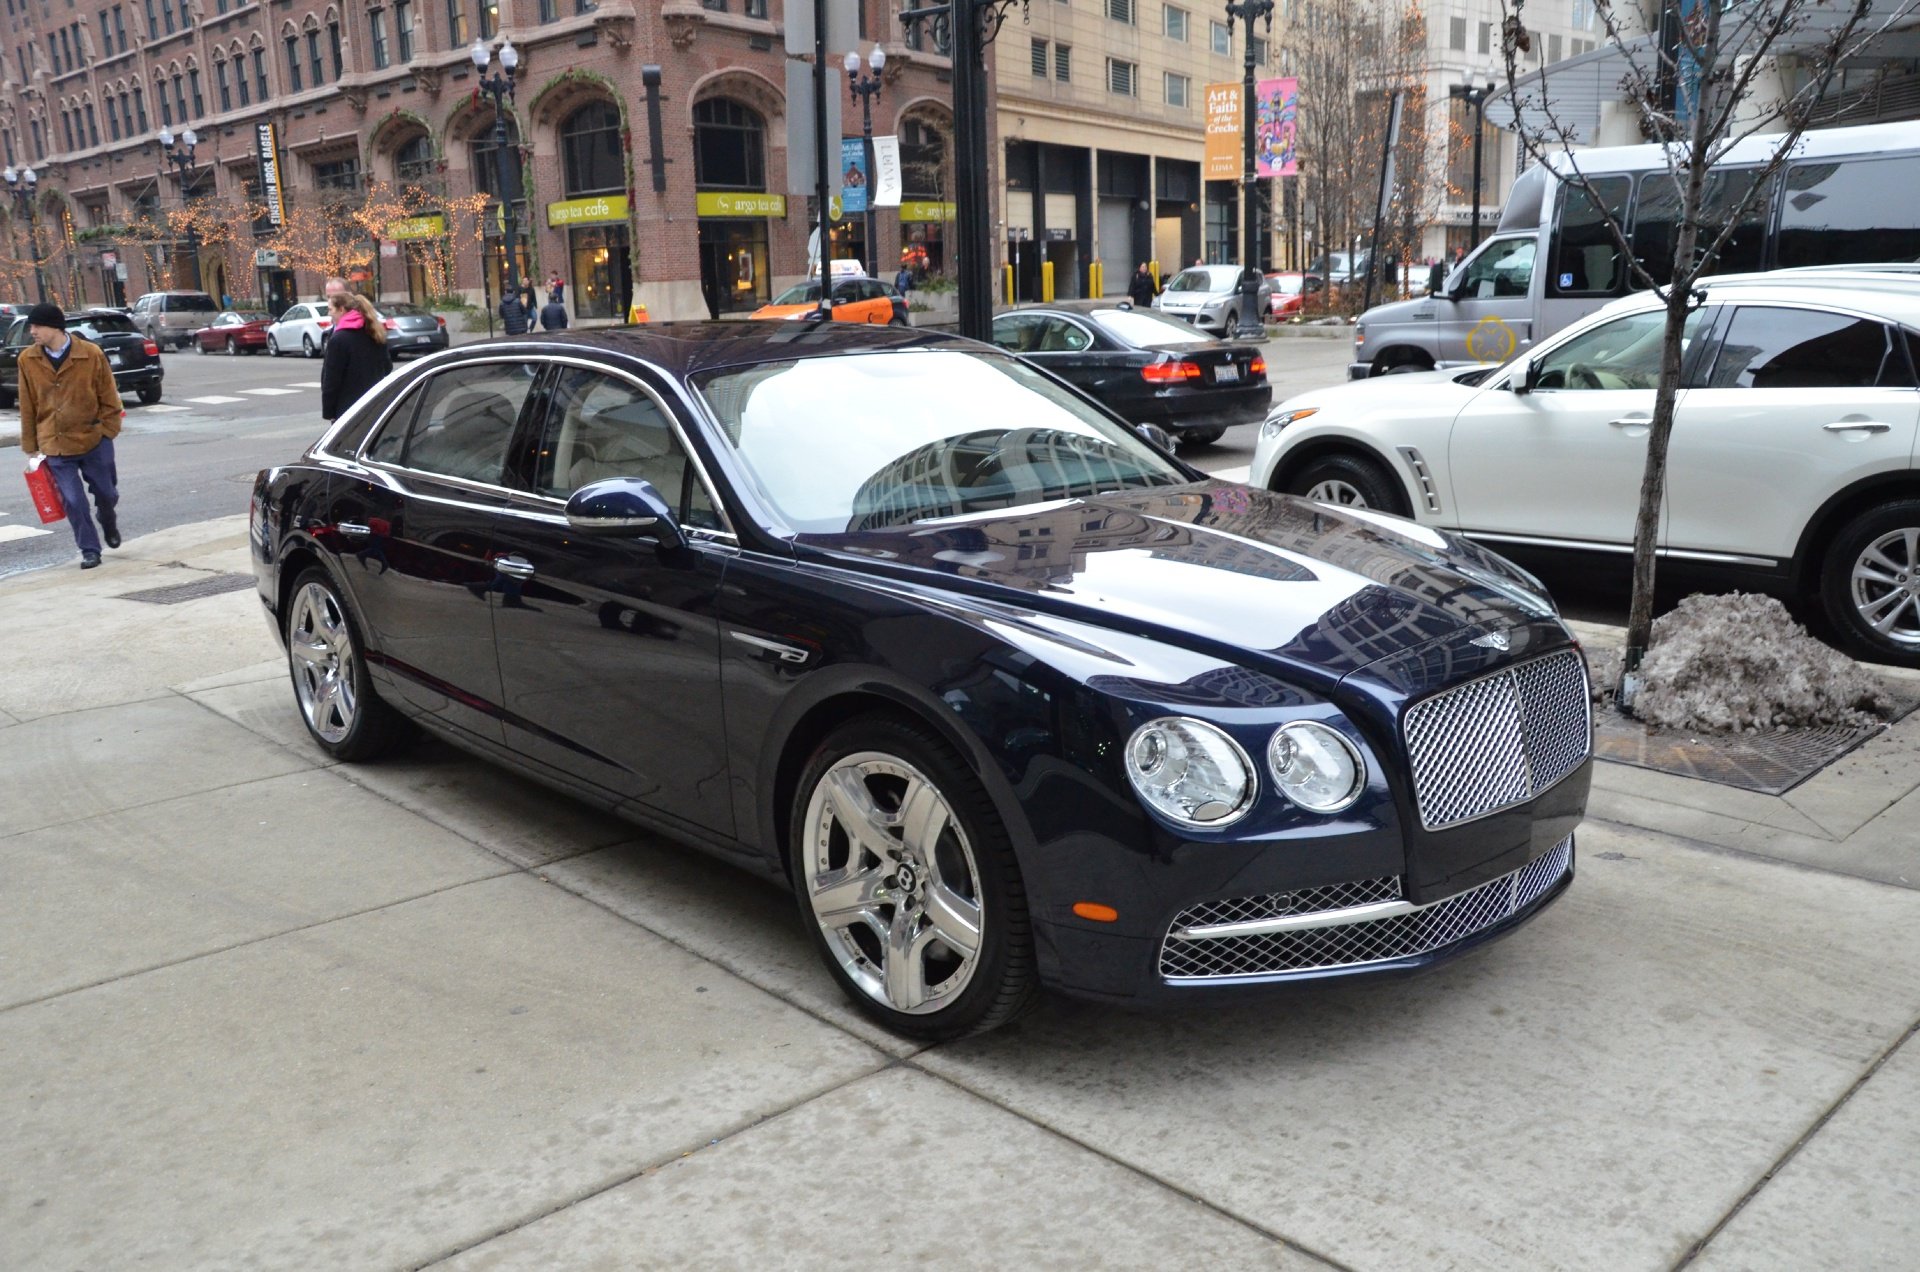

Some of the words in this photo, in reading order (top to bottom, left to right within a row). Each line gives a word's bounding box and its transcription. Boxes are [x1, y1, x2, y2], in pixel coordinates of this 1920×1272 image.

[1208, 90, 1227, 102] Art
[1229, 89, 1238, 100] &
[1209, 101, 1237, 114] Faith
[1207, 123, 1239, 133] Creche
[259, 124, 274, 158] BAGELS
[267, 185, 281, 224] EINSTEIN
[555, 207, 569, 222] argo
[570, 206, 582, 218] tea
[584, 199, 609, 216] café
[735, 200, 756, 214] argo
